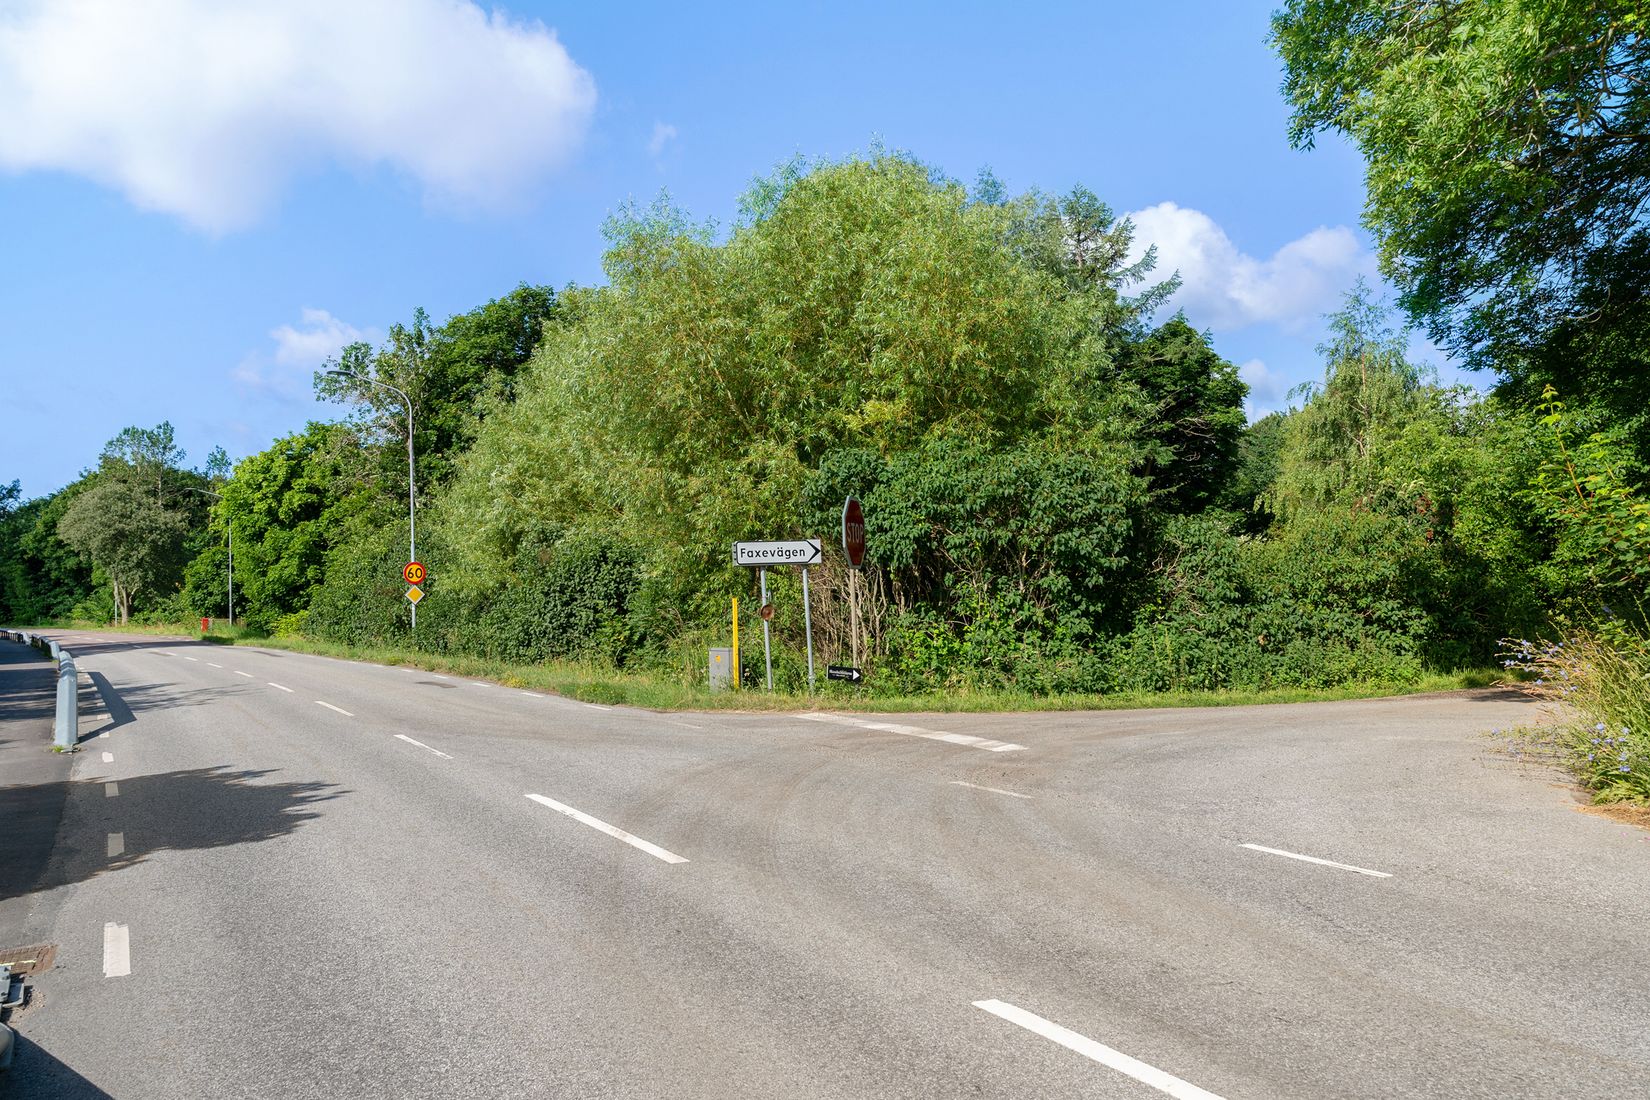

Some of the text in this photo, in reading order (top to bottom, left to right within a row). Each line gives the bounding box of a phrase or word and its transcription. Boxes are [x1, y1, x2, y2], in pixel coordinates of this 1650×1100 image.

[847, 522, 864, 544] STOP
[740, 547, 806, 559] Faxevägen
[408, 567, 423, 578] 60
